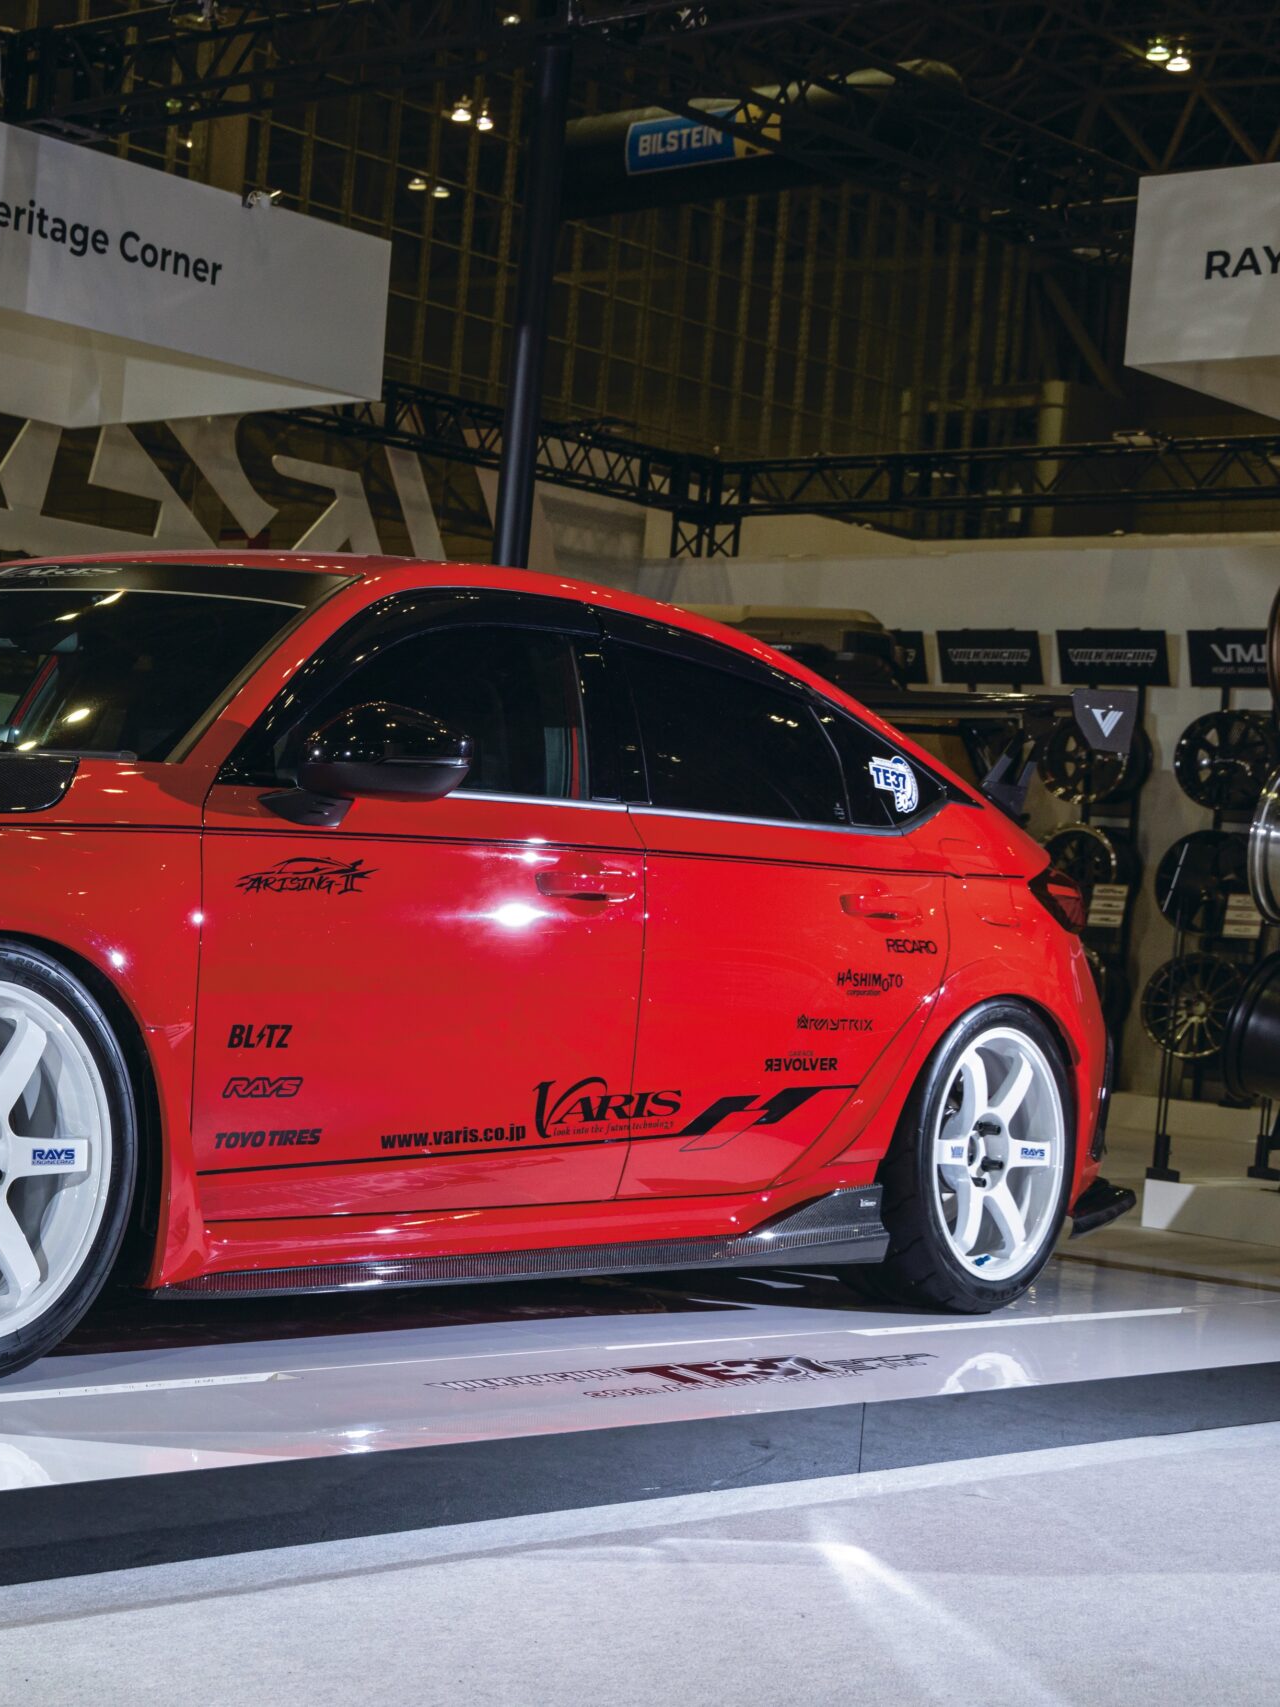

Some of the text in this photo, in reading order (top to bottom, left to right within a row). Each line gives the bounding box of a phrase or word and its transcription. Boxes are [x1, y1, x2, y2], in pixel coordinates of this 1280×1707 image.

[638, 125, 723, 157] BILSTEIN
[119, 230, 222, 286] Corner
[872, 767, 907, 789] TE37
[885, 938, 938, 955] RECARO
[837, 968, 903, 992] HASHIMOTO
[227, 1024, 293, 1048] BLITZ
[222, 1076, 303, 1098] RAYS
[532, 1076, 682, 1138] VARIS
[215, 1128, 322, 1149] TOYO TIRES
[380, 1123, 527, 1149] www.varis.co.jp
[591, 1125, 604, 1134] the
[32, 1149, 75, 1160] RAYS
[1021, 1148, 1045, 1157] RAYS
[620, 1354, 840, 1387] TE37
